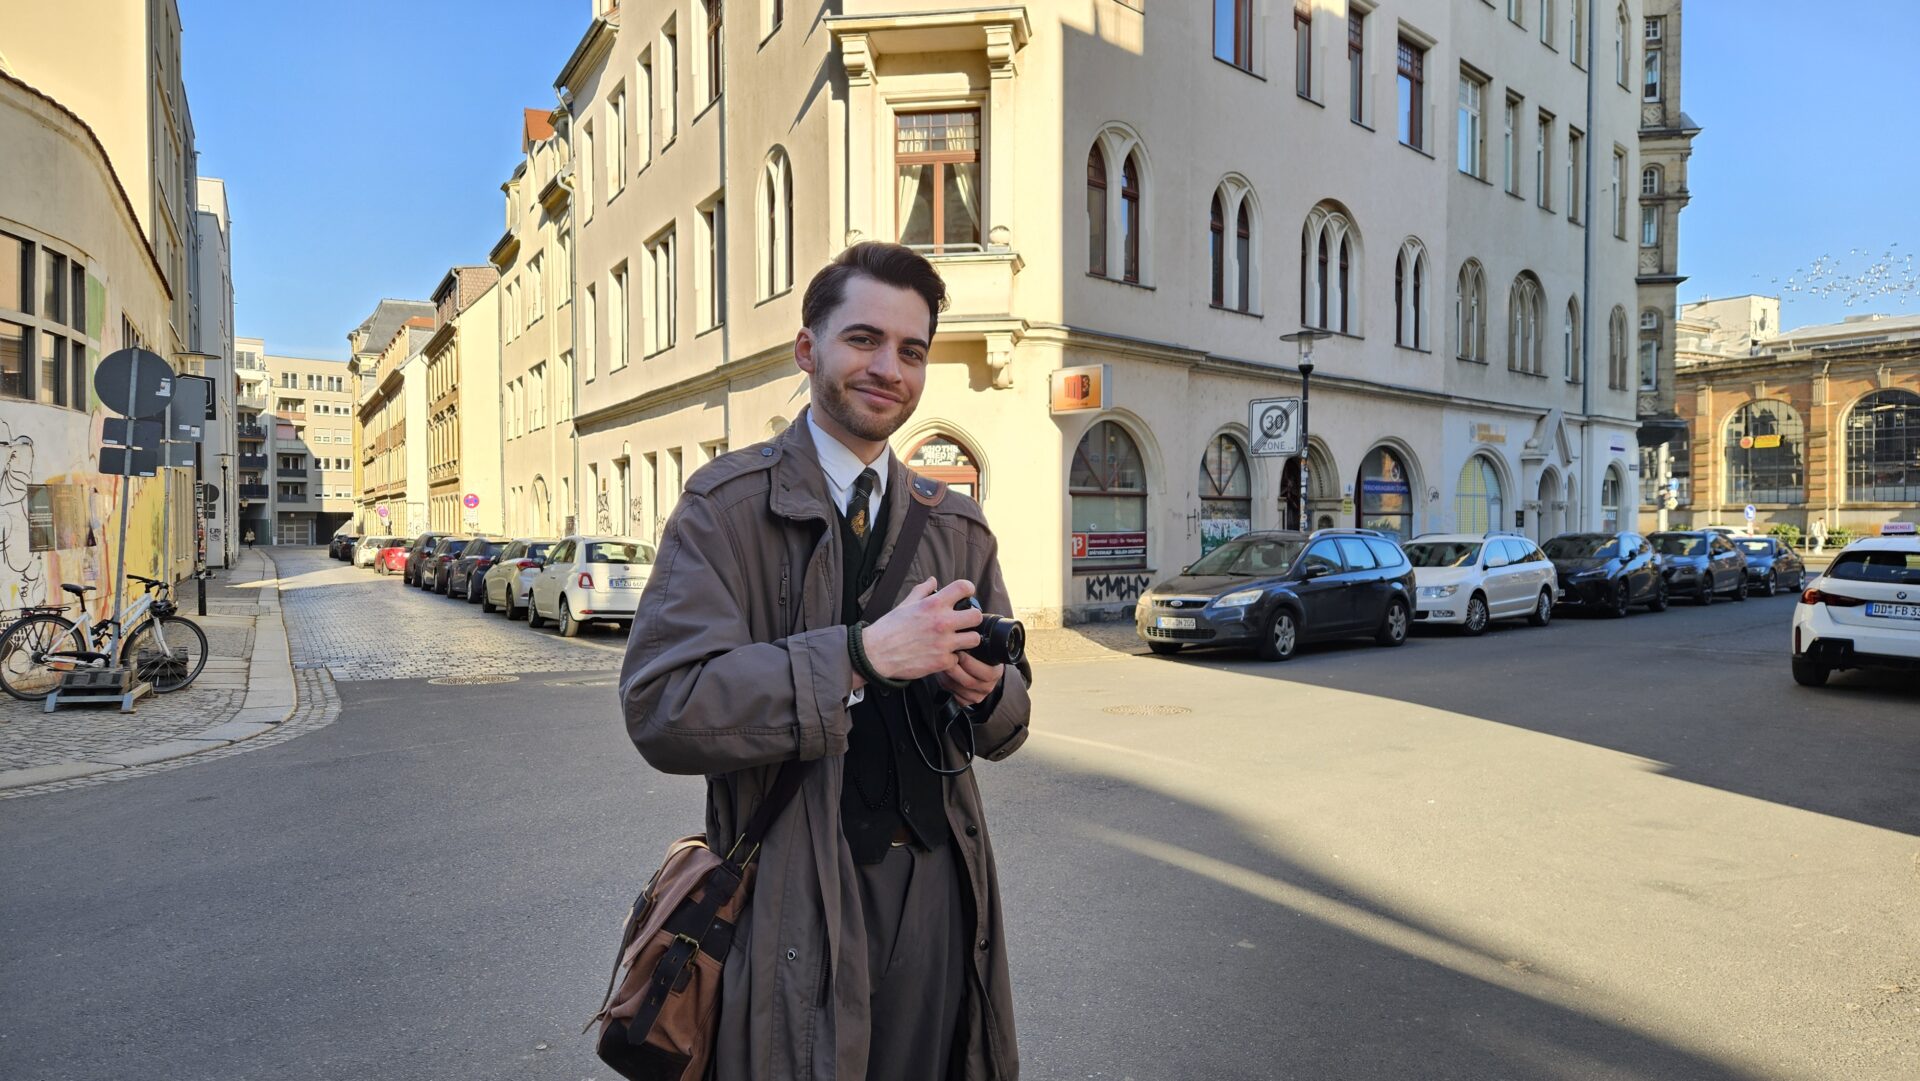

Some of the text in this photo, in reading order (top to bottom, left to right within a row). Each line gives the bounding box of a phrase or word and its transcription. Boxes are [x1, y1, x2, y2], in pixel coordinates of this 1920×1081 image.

[1265, 414, 1284, 430] 30
[1262, 441, 1285, 450] ZONE
[1873, 604, 1887, 614] DD
[1894, 606, 1908, 616] FB
